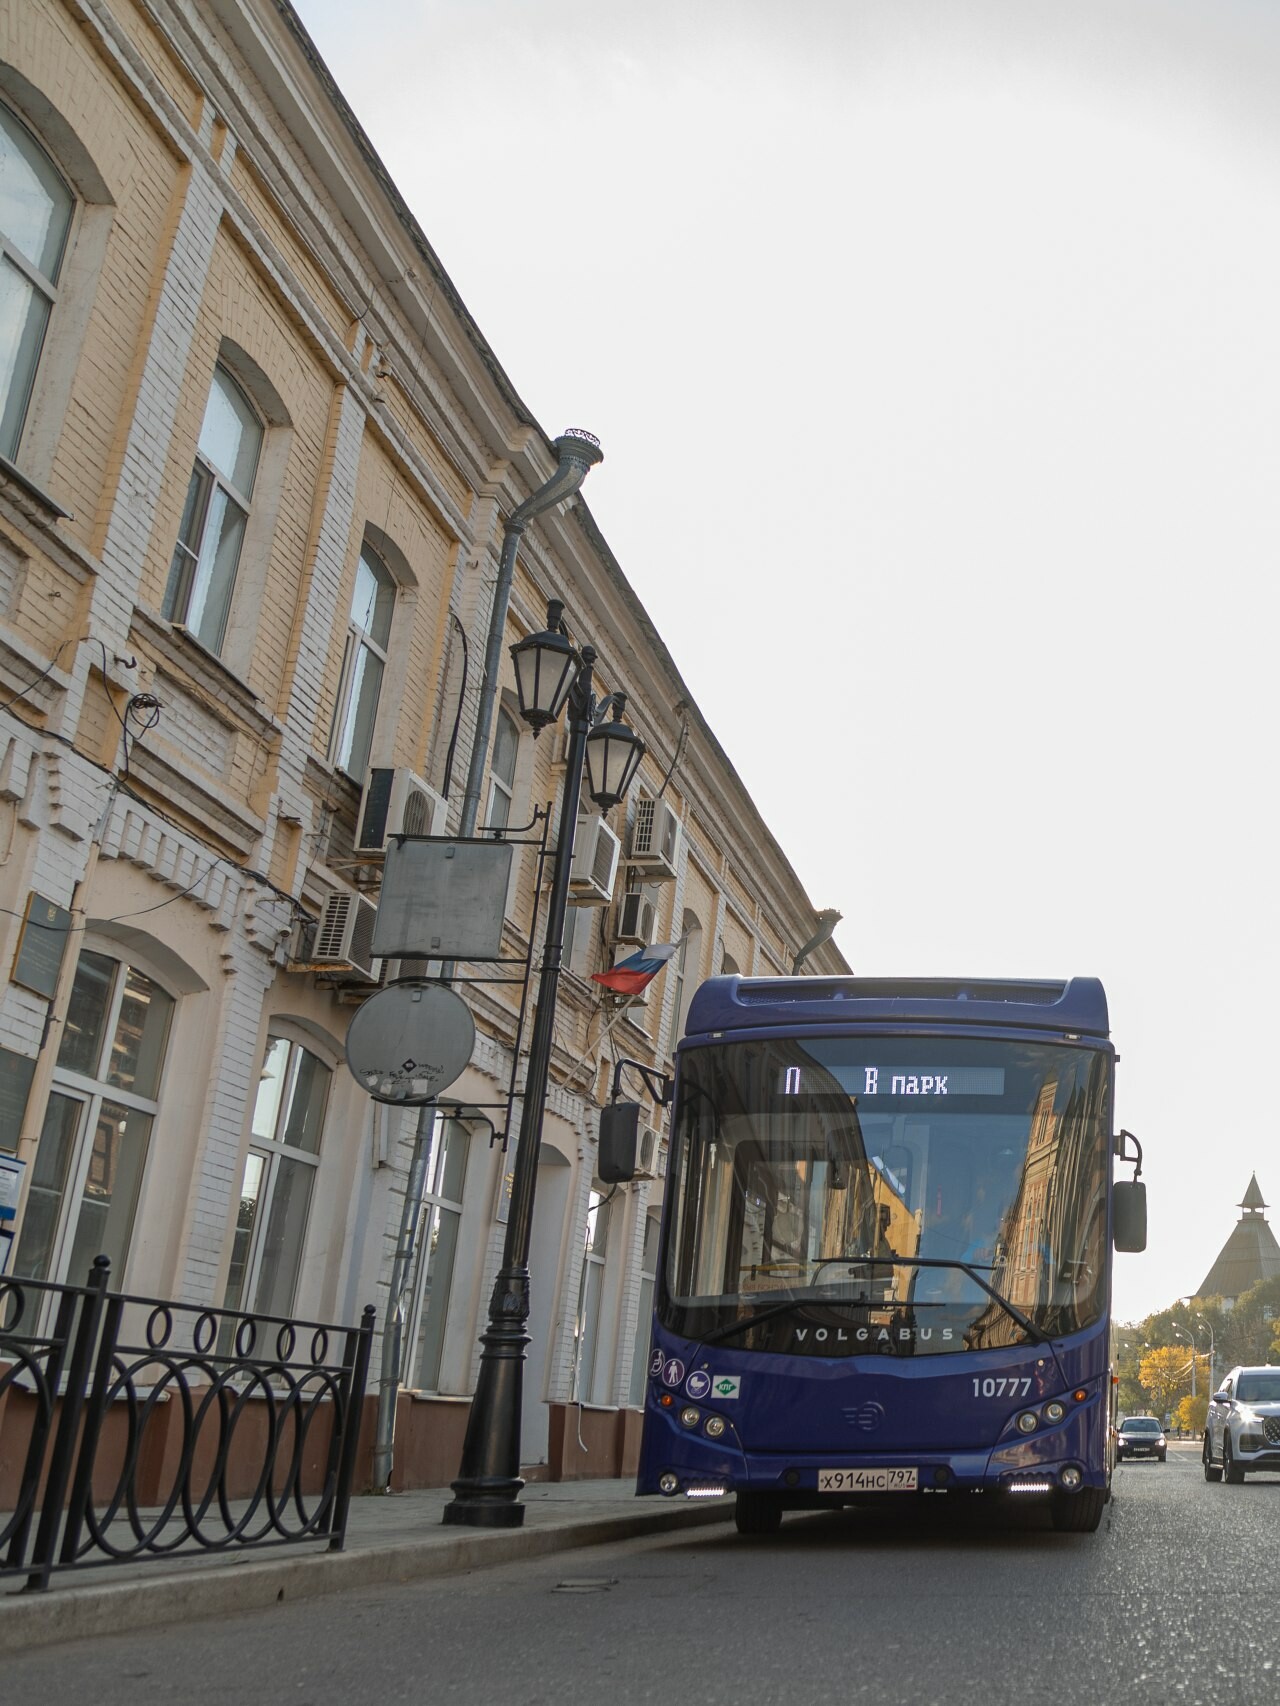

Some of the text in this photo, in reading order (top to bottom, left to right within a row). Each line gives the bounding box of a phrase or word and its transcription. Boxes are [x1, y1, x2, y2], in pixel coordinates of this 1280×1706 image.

[785, 1066, 948, 1095] П В парк
[795, 1327, 954, 1341] VOLGABUS
[718, 1383, 734, 1391] КПГ
[972, 1377, 1032, 1398] 10777
[888, 1470, 914, 1484] 797
